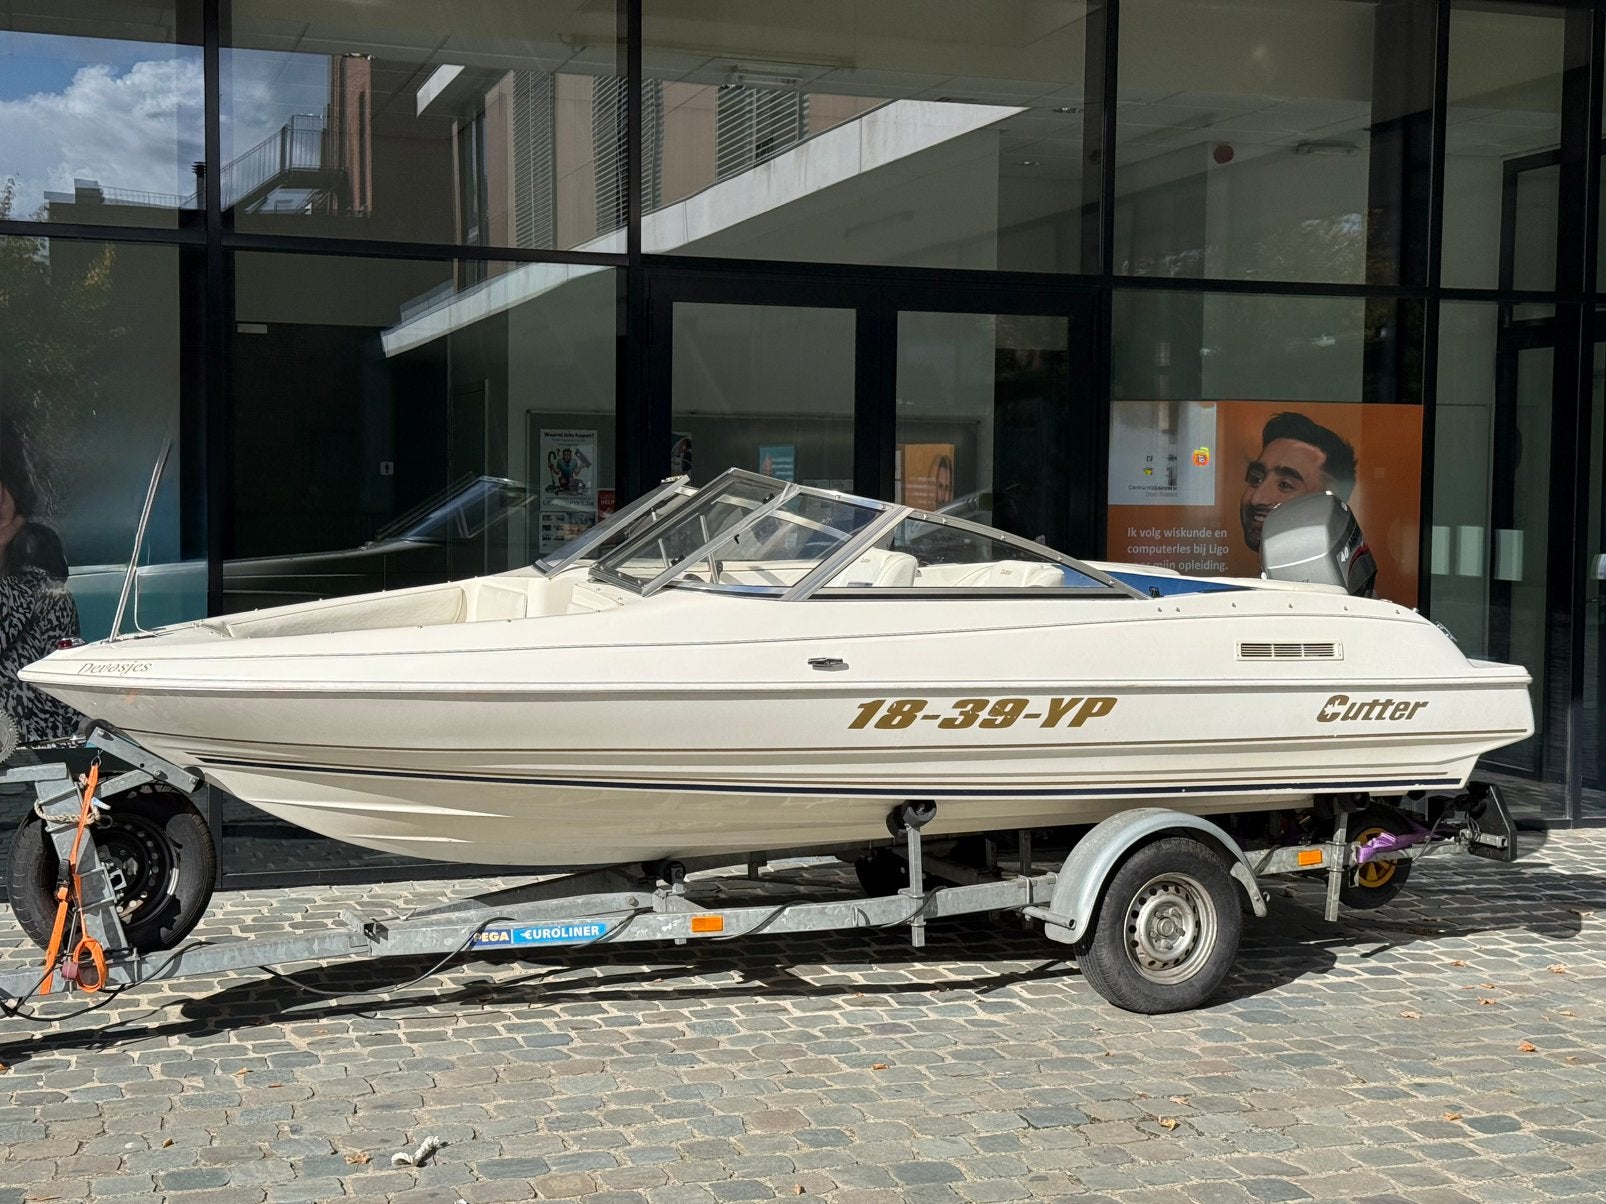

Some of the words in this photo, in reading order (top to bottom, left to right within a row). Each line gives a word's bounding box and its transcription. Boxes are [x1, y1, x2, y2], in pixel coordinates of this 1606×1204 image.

[1127, 527, 1137, 537] Ik
[1140, 527, 1160, 539] volg
[1164, 527, 1212, 537] wiskunde
[1127, 544, 1191, 555] computerles
[1193, 543, 1206, 555] bij
[1209, 544, 1229, 555] Ligo
[1179, 560, 1228, 572] opleiding.
[848, 697, 1118, 730] 18-39-YP
[1317, 695, 1429, 722] Cutter
